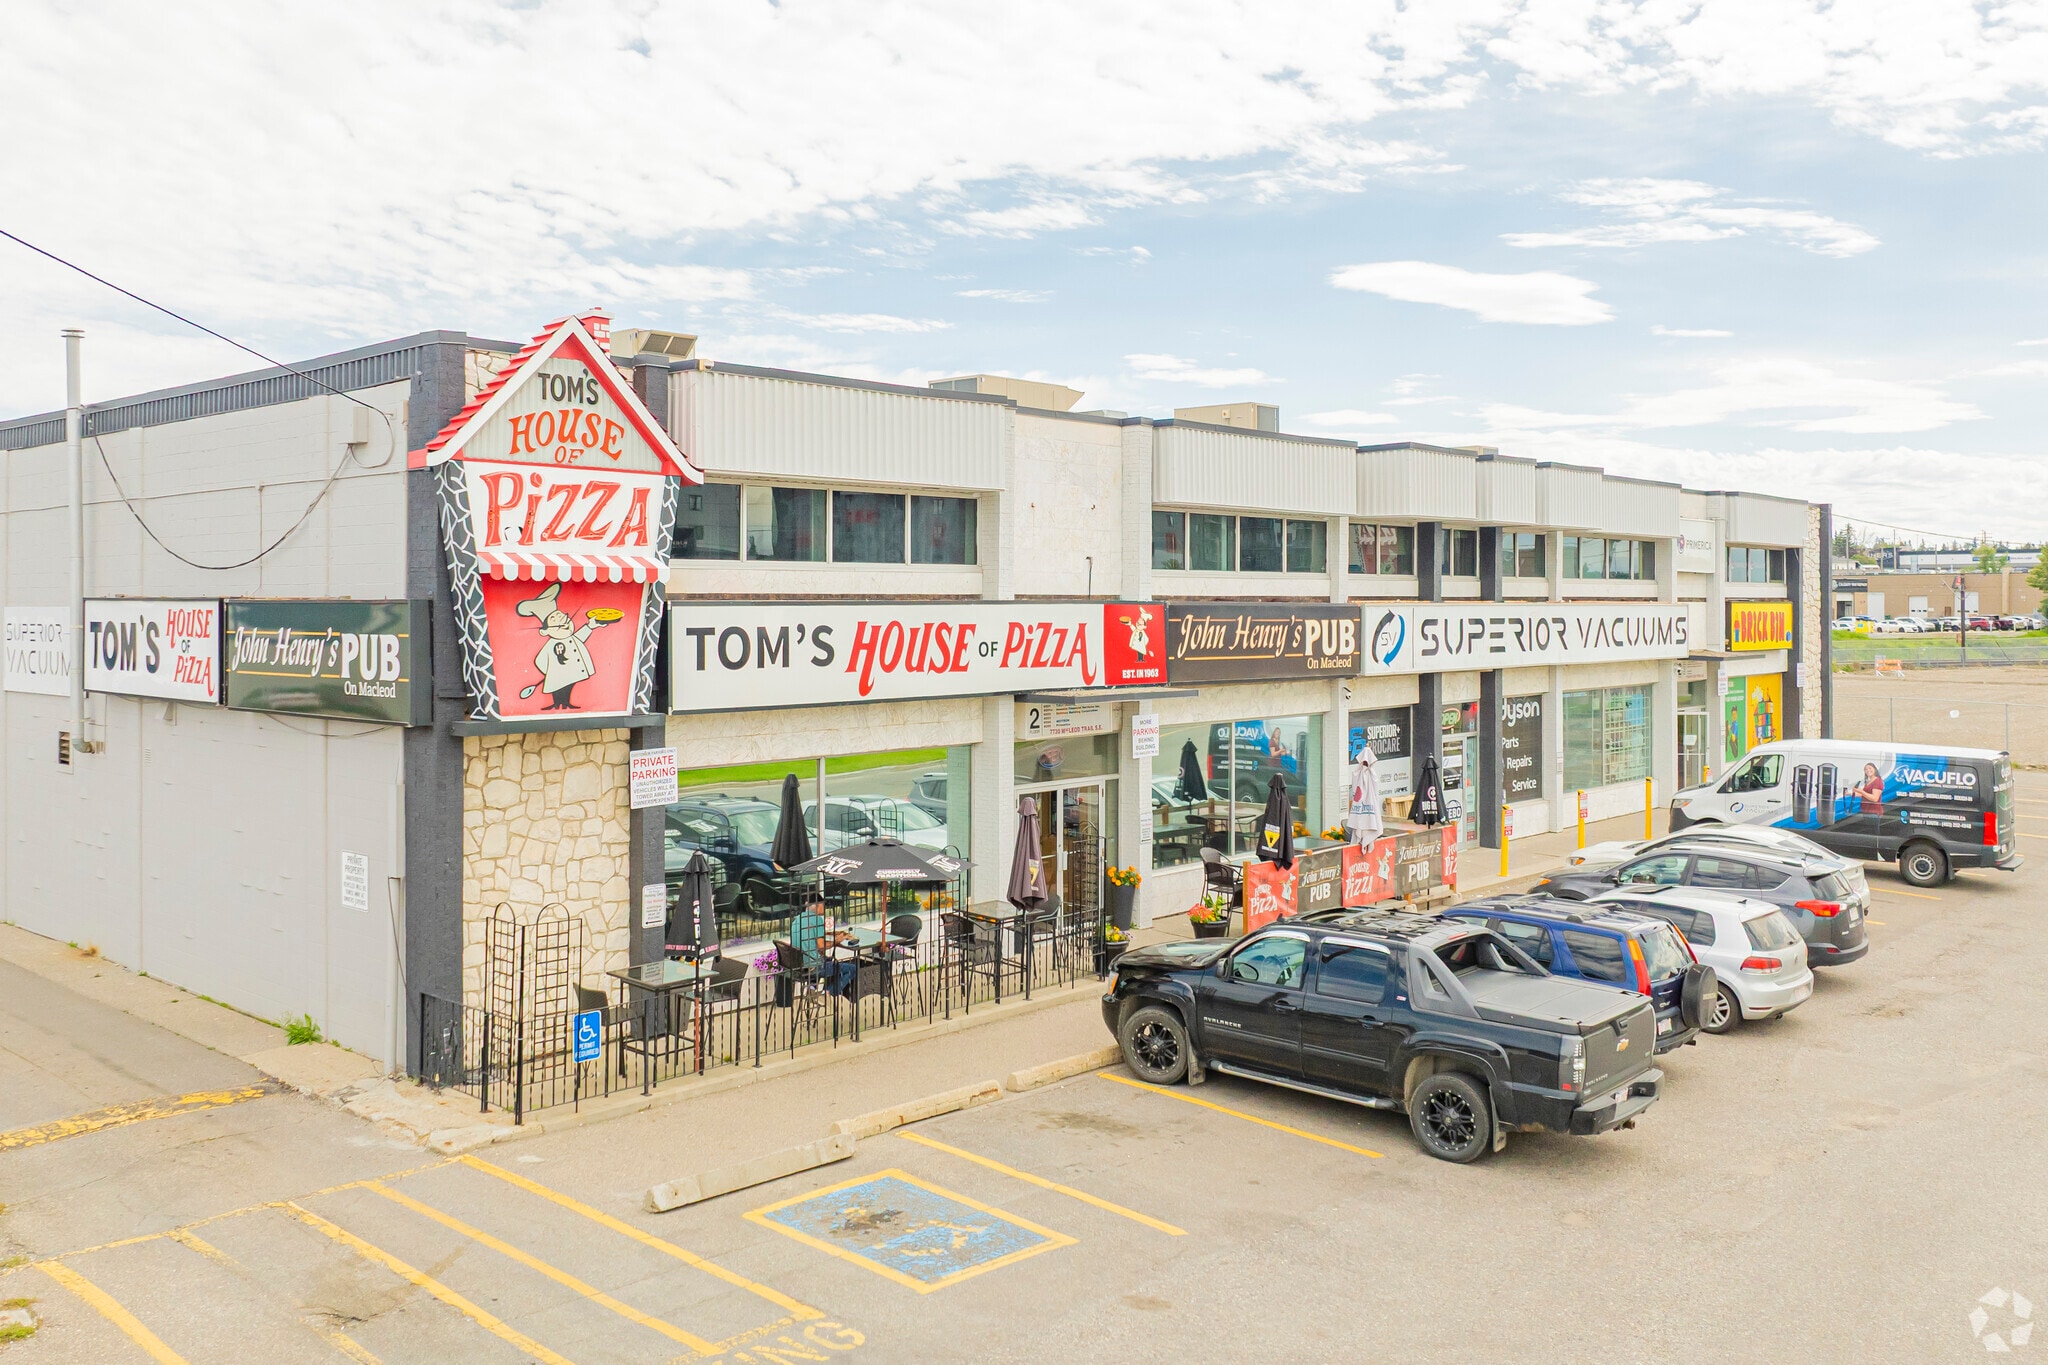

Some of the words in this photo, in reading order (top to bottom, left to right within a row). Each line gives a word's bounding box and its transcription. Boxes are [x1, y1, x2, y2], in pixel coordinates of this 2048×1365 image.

[538, 368, 599, 405] TOM'S
[508, 408, 625, 461] HOUSE
[554, 446, 585, 463] OF
[1686, 539, 1712, 550] PRIMERICA
[7, 623, 62, 642] SUPERIOR
[166, 608, 213, 648] HOUSE
[1177, 614, 1227, 659] John
[1228, 614, 1302, 657] Henry's
[1305, 619, 1355, 656] PUB
[1421, 617, 1568, 656] SUPERIOR
[1577, 617, 1687, 648] VACUUMS
[90, 614, 160, 673] TOM'S
[181, 639, 191, 653] OF
[231, 626, 269, 672] John
[270, 626, 340, 677] Henry's
[341, 633, 401, 681] PUB
[686, 623, 835, 671] TOM'S
[844, 620, 977, 697] HOUSE
[978, 641, 998, 658] OF
[1307, 657, 1319, 670] On
[1320, 656, 1352, 669] Macleod
[1122, 669, 1136, 679] EST.
[1137, 669, 1144, 678] IN
[1144, 668, 1159, 678] 1963
[344, 681, 358, 696] On
[358, 682, 396, 698] Macleod
[1029, 708, 1040, 729] 2
[1441, 712, 1459, 725] PEN
[1132, 727, 1158, 736] PARKING
[633, 755, 674, 768] PRIVATE
[1507, 755, 1532, 771] Repairs
[632, 767, 676, 780] PARKING
[1904, 769, 1977, 786] VACUFLO
[1512, 778, 1537, 792] Service
[1446, 806, 1461, 819] EBO
[1409, 860, 1430, 882] PUB
[1310, 885, 1331, 903] PUB
